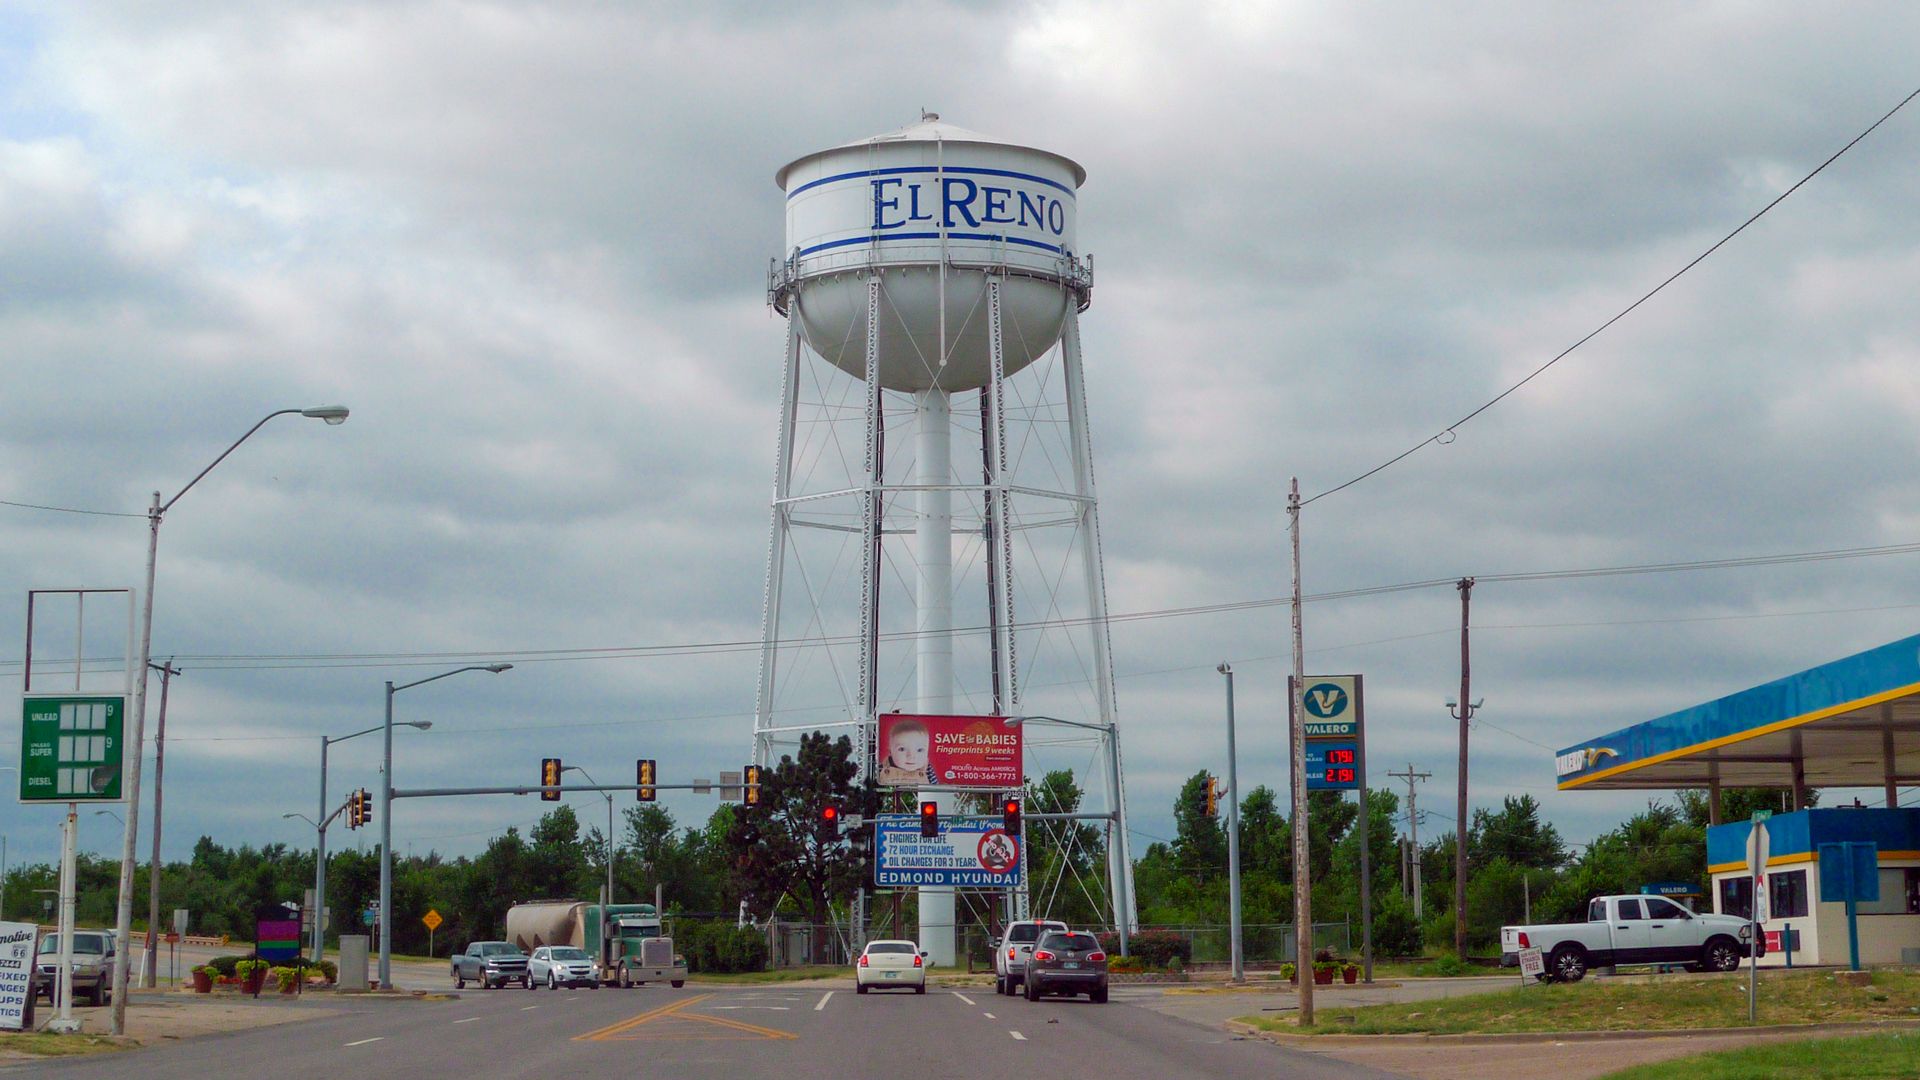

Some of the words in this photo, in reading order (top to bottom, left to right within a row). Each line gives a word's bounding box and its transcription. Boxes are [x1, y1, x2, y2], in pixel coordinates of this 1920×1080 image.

[871, 177, 933, 230] EL
[934, 177, 1065, 236] RENO
[31, 713, 58, 721] UNLEAD
[107, 705, 114, 716] 9
[1305, 724, 1349, 734] VALERO
[106, 737, 113, 748] 9
[935, 733, 965, 744] SAVE
[976, 734, 1017, 745] BABIES
[30, 748, 52, 756] SUPER
[936, 745, 983, 754] Fingerprints
[957, 772, 1016, 780] 1-800-366-7773
[28, 777, 52, 786] DIESEL
[889, 833, 917, 844] ENGINES
[919, 835, 933, 844] FOR
[934, 834, 946, 844] LIFE
[889, 845, 898, 855] 72
[899, 845, 918, 855] HOUR
[919, 845, 954, 855] EXCHANGE
[889, 857, 900, 867] OIL
[901, 857, 933, 867] CHANGES
[934, 857, 948, 867] FOR
[948, 858, 954, 867] 3
[955, 857, 977, 867] YEARS
[880, 873, 944, 883] EDMOND
[951, 873, 1018, 884] HYUNDAI
[1660, 886, 1688, 894] VALERO
